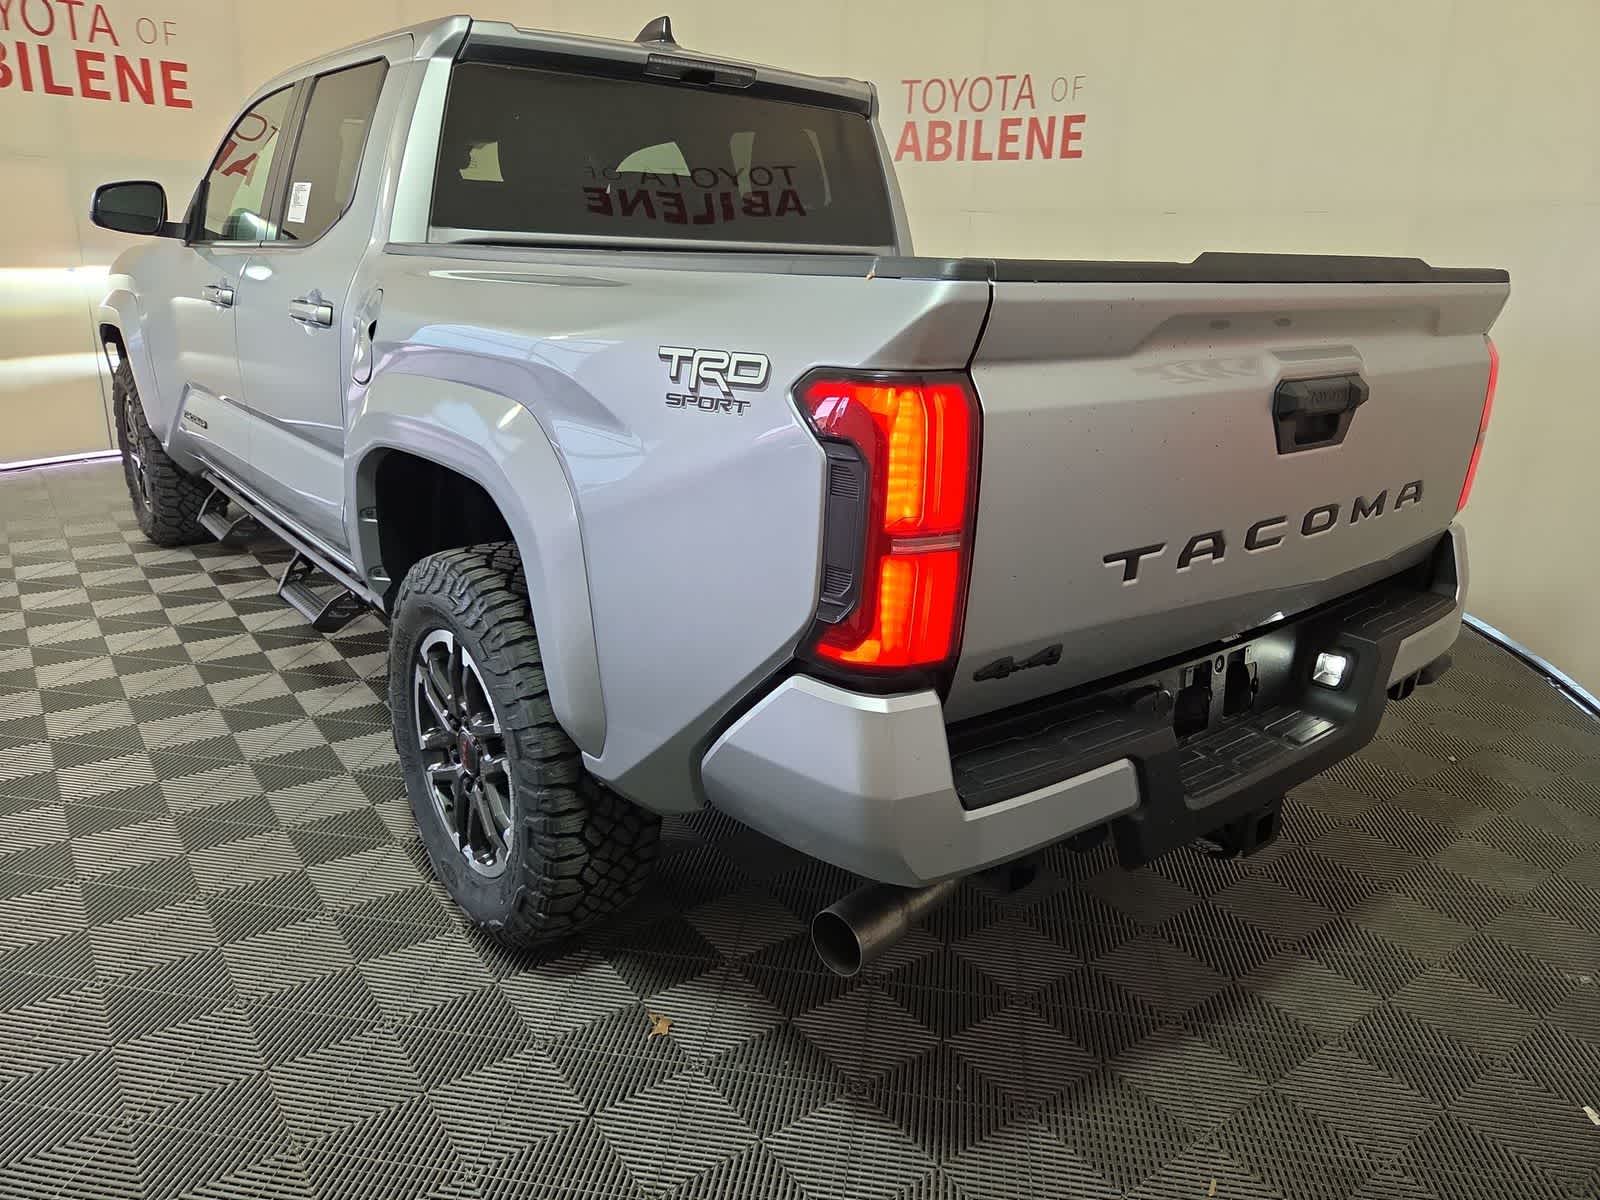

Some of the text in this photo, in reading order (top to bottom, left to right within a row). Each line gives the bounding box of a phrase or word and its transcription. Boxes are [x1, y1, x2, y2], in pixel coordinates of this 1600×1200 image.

[135, 17, 177, 46] OF
[902, 74, 1087, 114] TOYOTA OF
[894, 114, 1087, 162] ABILENE
[658, 345, 773, 399] TRD
[665, 393, 752, 416] SPORT
[1102, 479, 1424, 586] TACOMA
